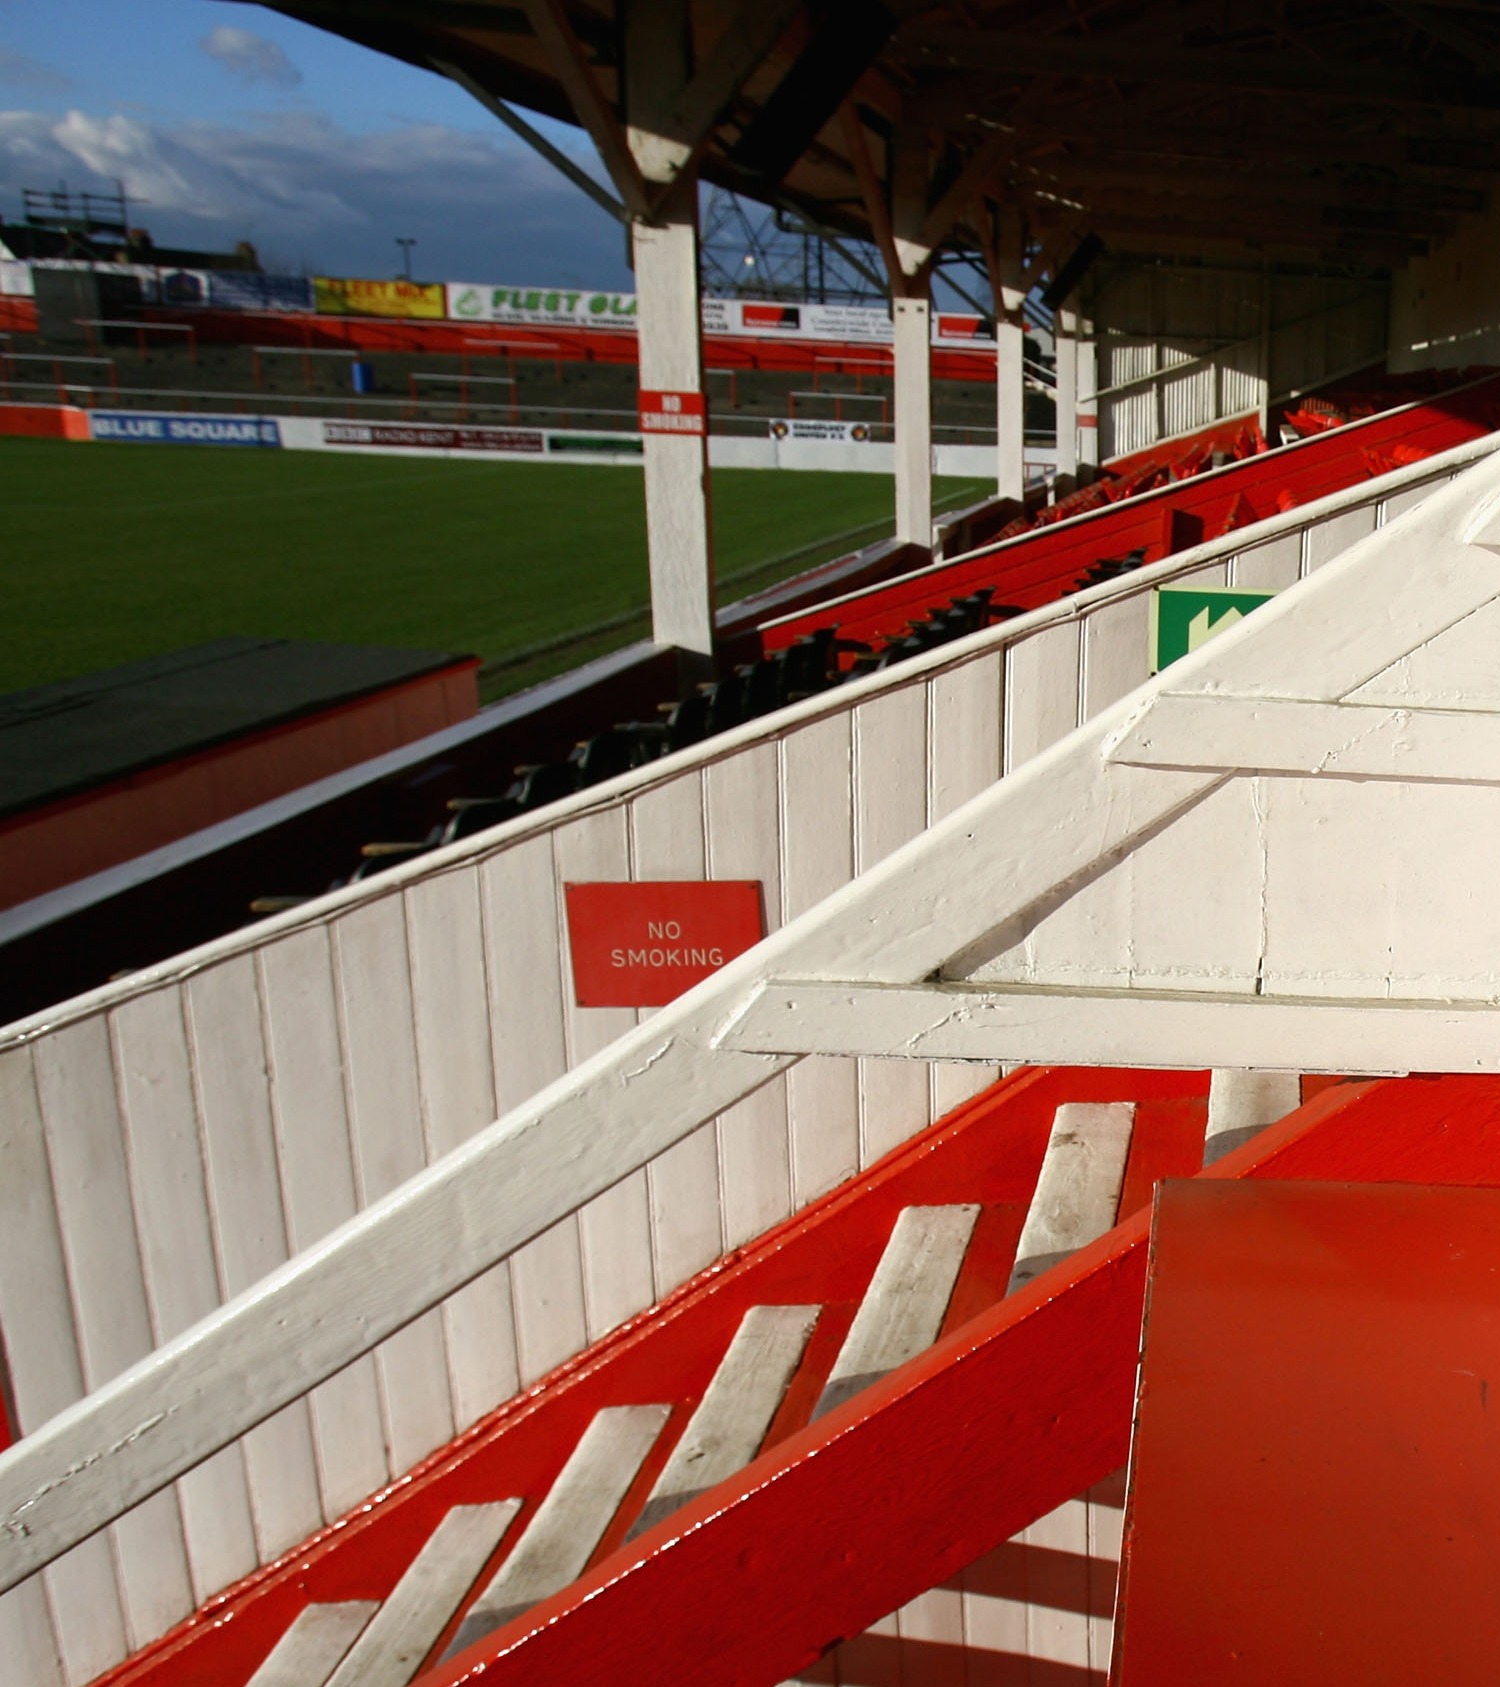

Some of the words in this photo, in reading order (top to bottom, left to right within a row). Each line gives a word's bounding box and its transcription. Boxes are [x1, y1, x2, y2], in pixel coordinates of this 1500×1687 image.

[492, 288, 580, 312] FLEET
[662, 394, 681, 412] NO
[94, 417, 166, 437] BLUE
[169, 420, 278, 442] SQUARE
[641, 412, 703, 431] SMOKING
[647, 921, 681, 940] NO
[611, 948, 724, 968] SMOKING
